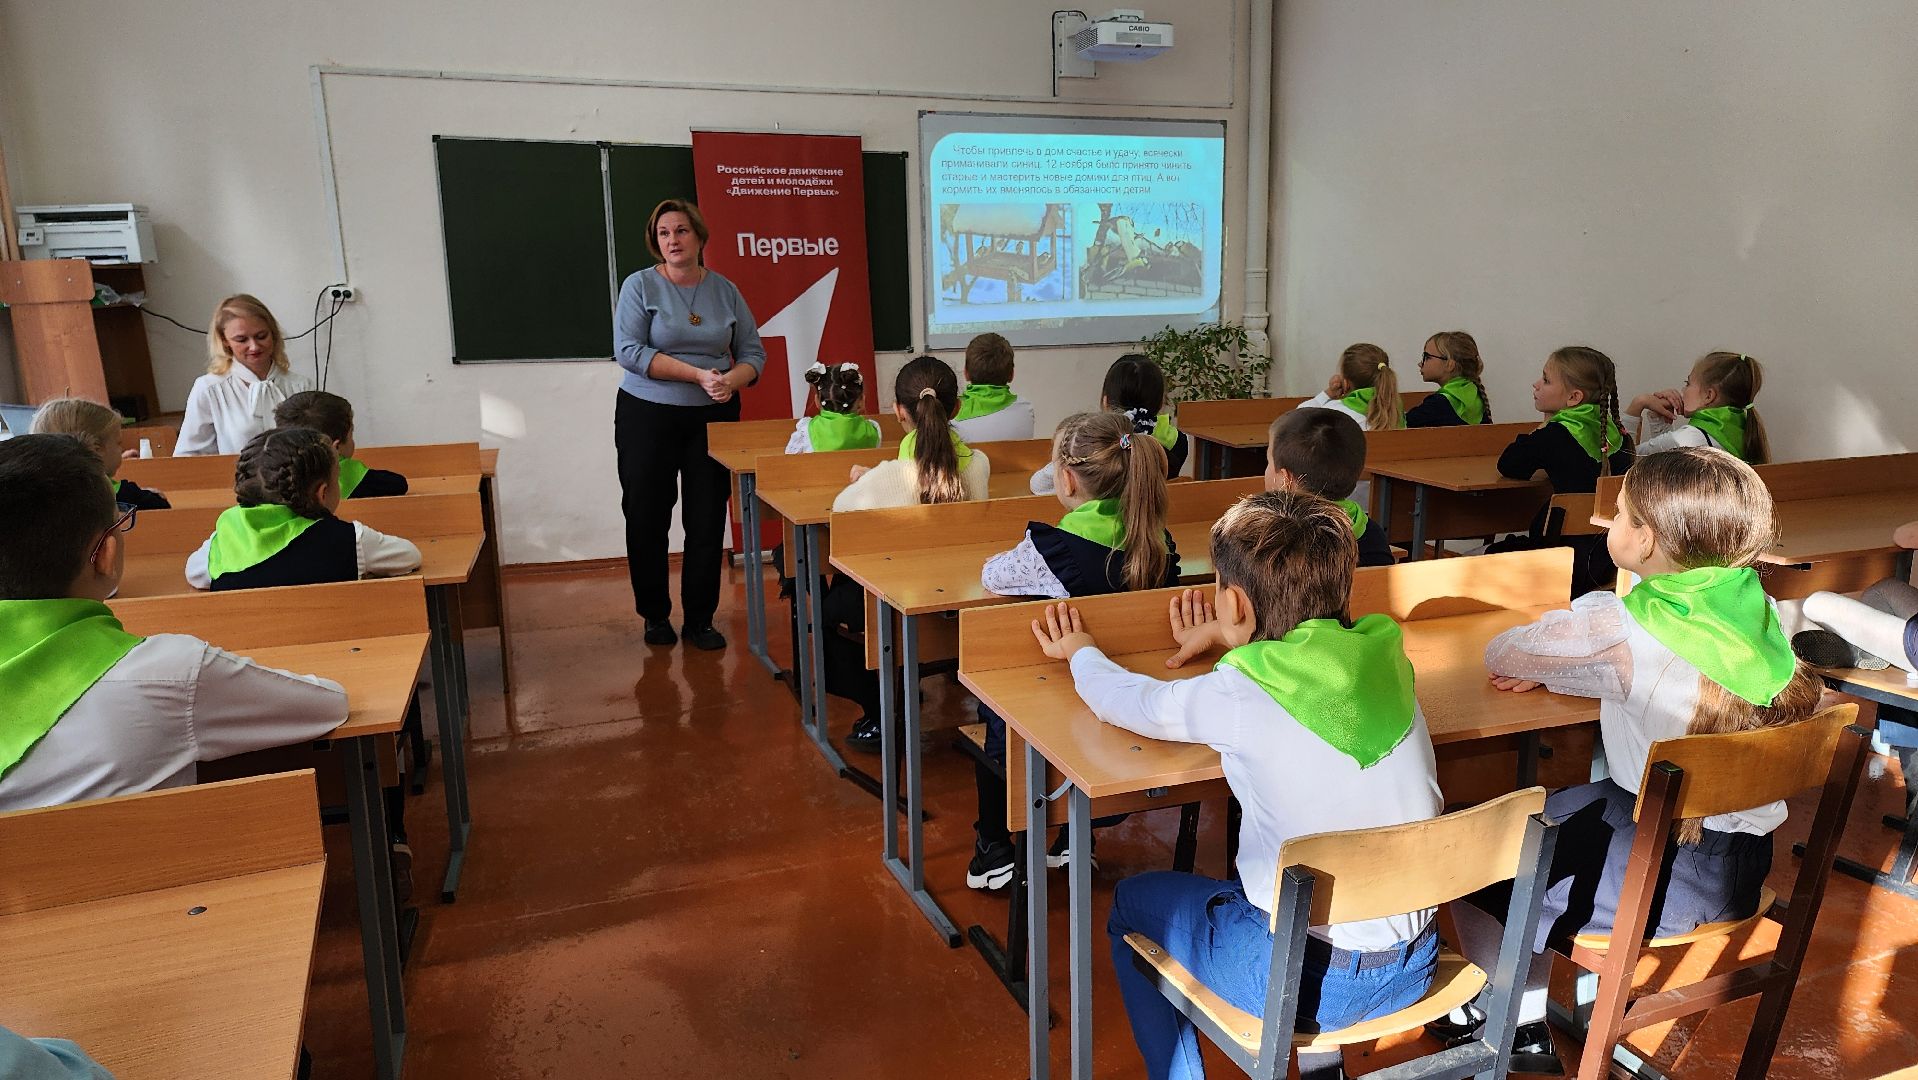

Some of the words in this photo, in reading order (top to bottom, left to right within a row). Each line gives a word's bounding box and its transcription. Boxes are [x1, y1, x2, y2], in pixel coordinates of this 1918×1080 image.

[1044, 148, 1064, 157] дом
[1066, 148, 1102, 156] счастье
[1105, 148, 1111, 156] и
[1046, 159, 1057, 169] 12
[1059, 160, 1093, 170] ноября
[1095, 160, 1120, 169] было
[1122, 161, 1159, 171] принято
[1161, 162, 1192, 170] чинить
[716, 165, 787, 176] Российское
[788, 168, 844, 177] движение
[731, 176, 765, 186] детей
[776, 177, 833, 187] молодёжи
[941, 174, 978, 183] старые
[990, 174, 1040, 183] мастерить
[1043, 174, 1073, 182] новые
[1075, 174, 1109, 183] домики
[1111, 174, 1129, 183] для
[1156, 172, 1164, 182] А
[726, 186, 791, 197] «Движение
[793, 187, 839, 197] Первых»
[942, 186, 983, 195] кормить
[986, 186, 997, 194] их
[1063, 185, 1121, 194] обязанности
[736, 232, 839, 264] Первые
